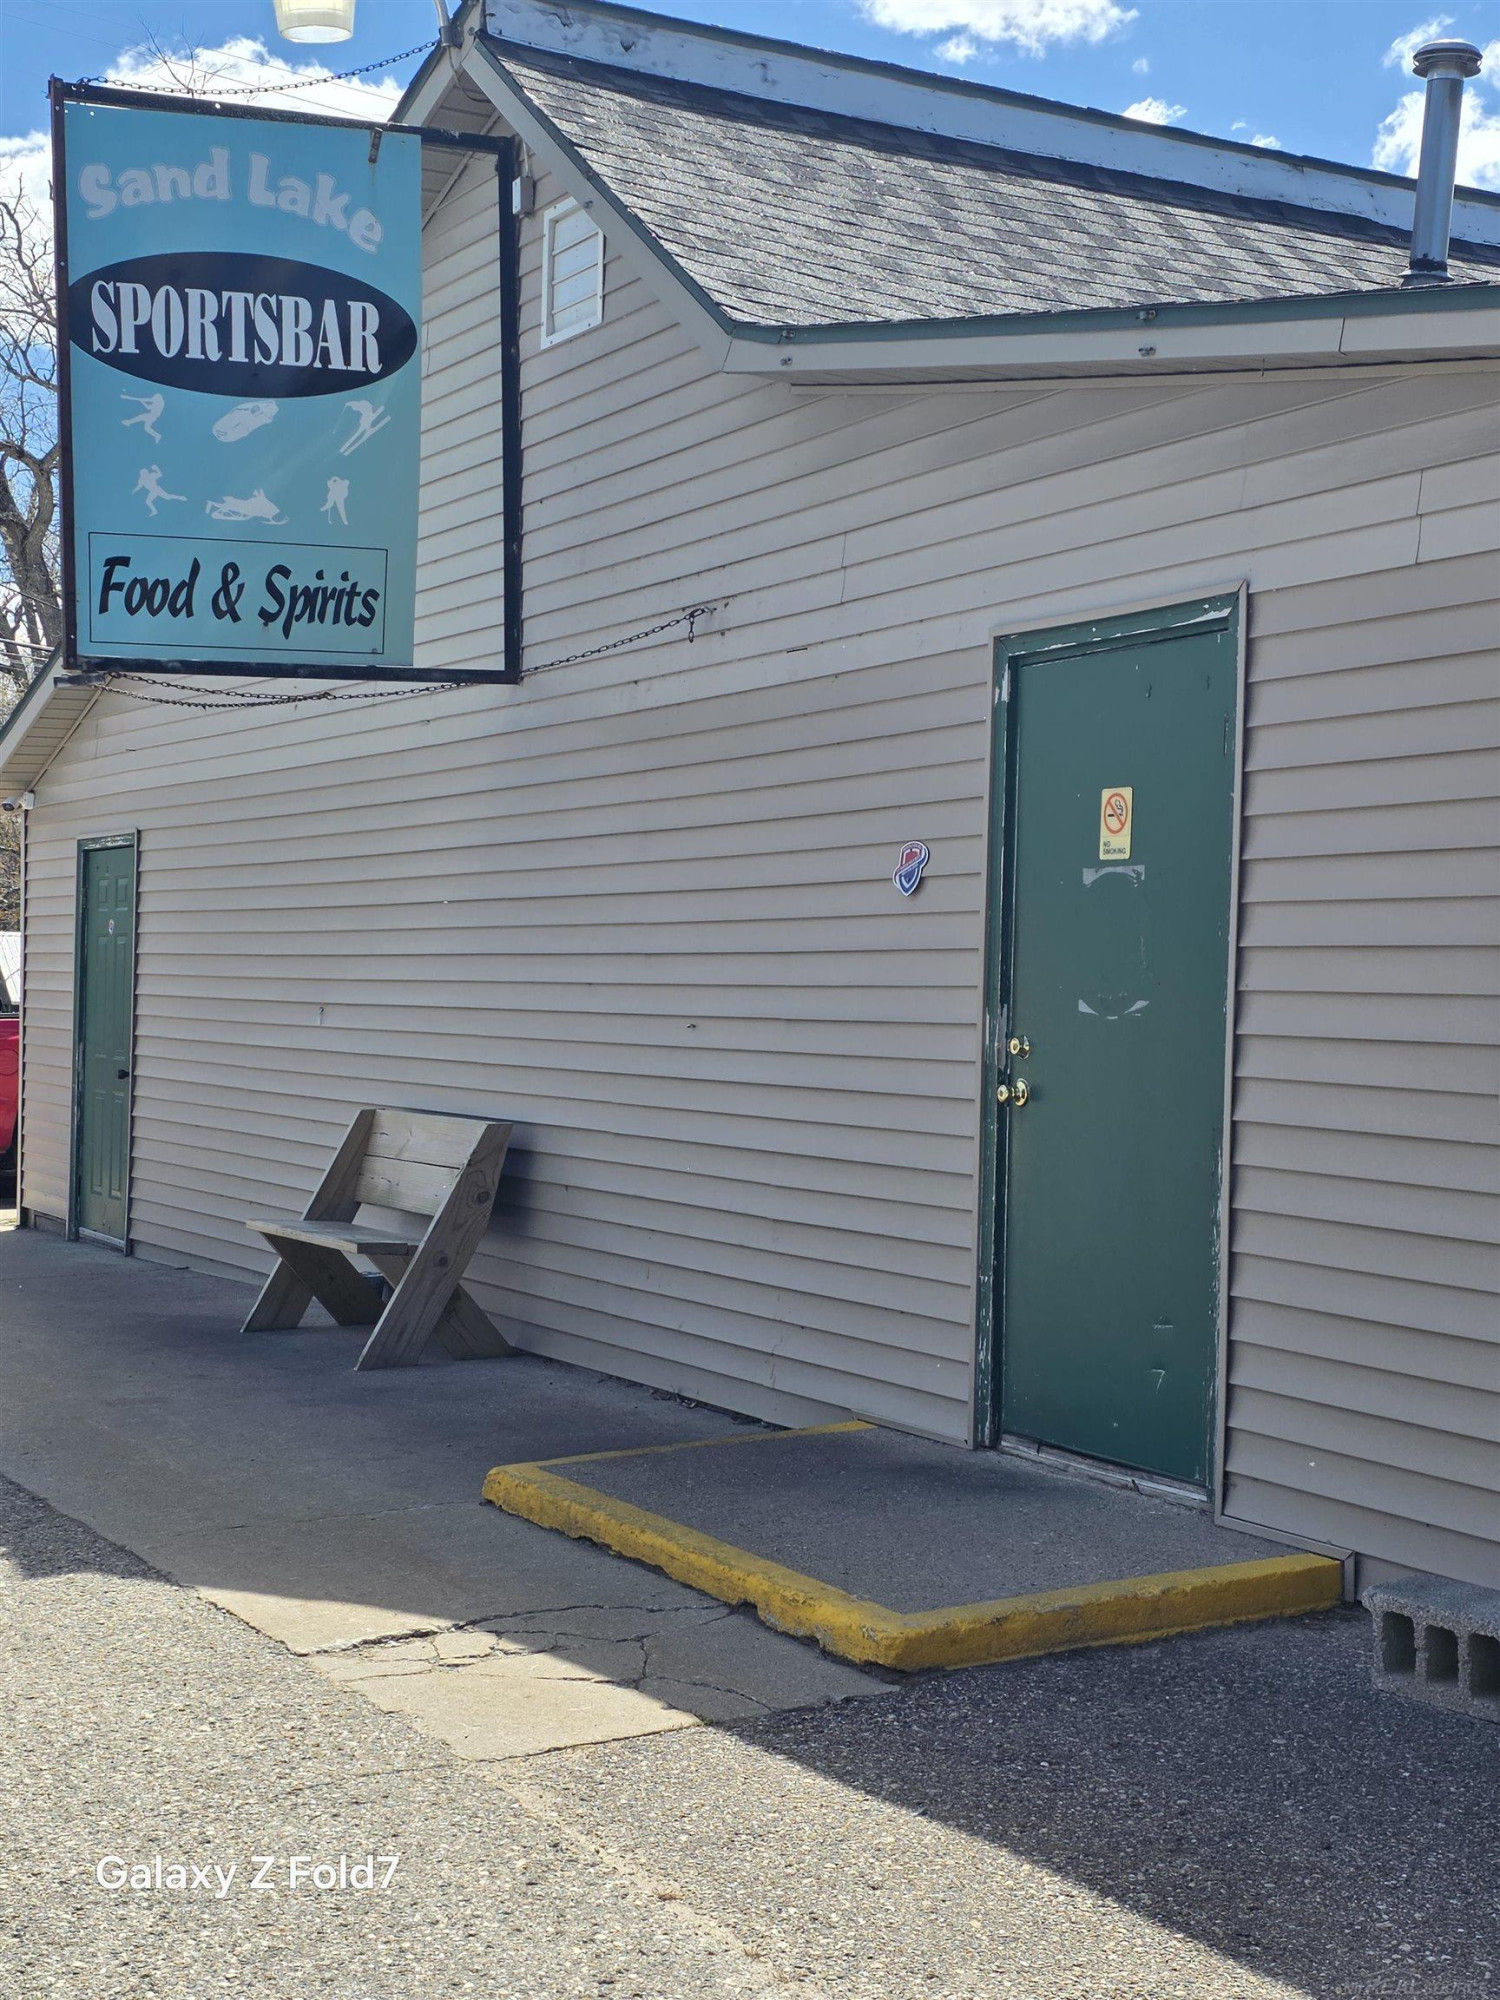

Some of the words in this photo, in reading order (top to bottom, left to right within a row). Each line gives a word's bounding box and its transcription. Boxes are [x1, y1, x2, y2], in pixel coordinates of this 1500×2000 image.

[78, 145, 232, 220] Sand
[248, 151, 385, 253] Lake
[90, 280, 382, 374] SPORTSBAR
[98, 555, 201, 618] Food
[211, 560, 245, 623] &
[258, 563, 381, 640] Spirits
[1102, 847, 1126, 855] SMOKING
